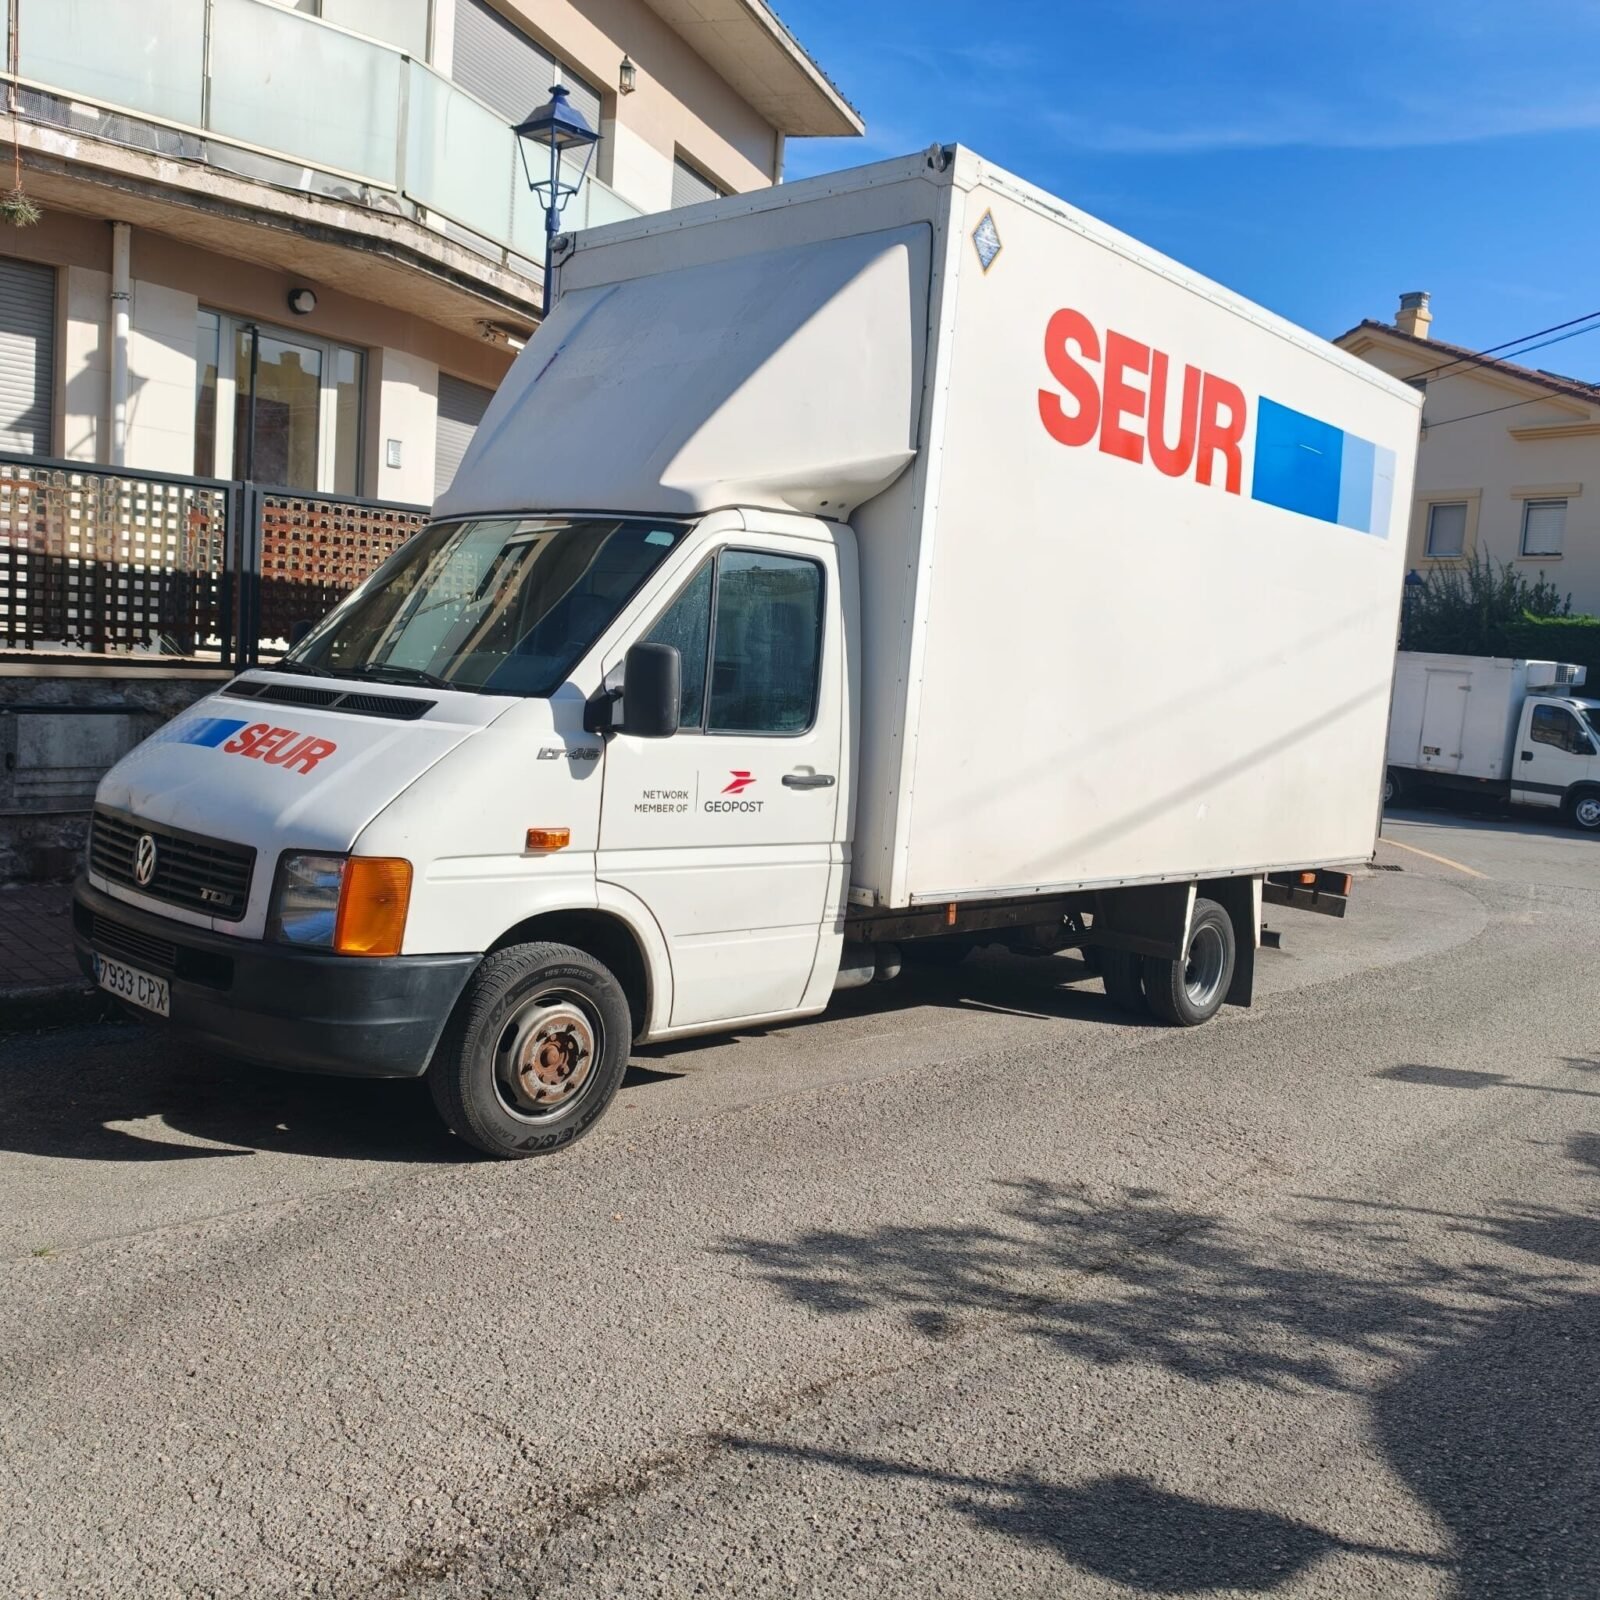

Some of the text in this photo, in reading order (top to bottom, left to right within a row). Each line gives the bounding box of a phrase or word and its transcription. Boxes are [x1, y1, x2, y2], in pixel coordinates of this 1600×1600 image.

[1038, 308, 1246, 495] SEUR
[223, 723, 337, 775] SEUR
[643, 790, 689, 799] NETWORK
[634, 803, 688, 813] MEMBER OF
[704, 801, 764, 812] GEOPOST
[200, 887, 234, 906] TDI
[100, 958, 165, 1011] 7933 CPX
